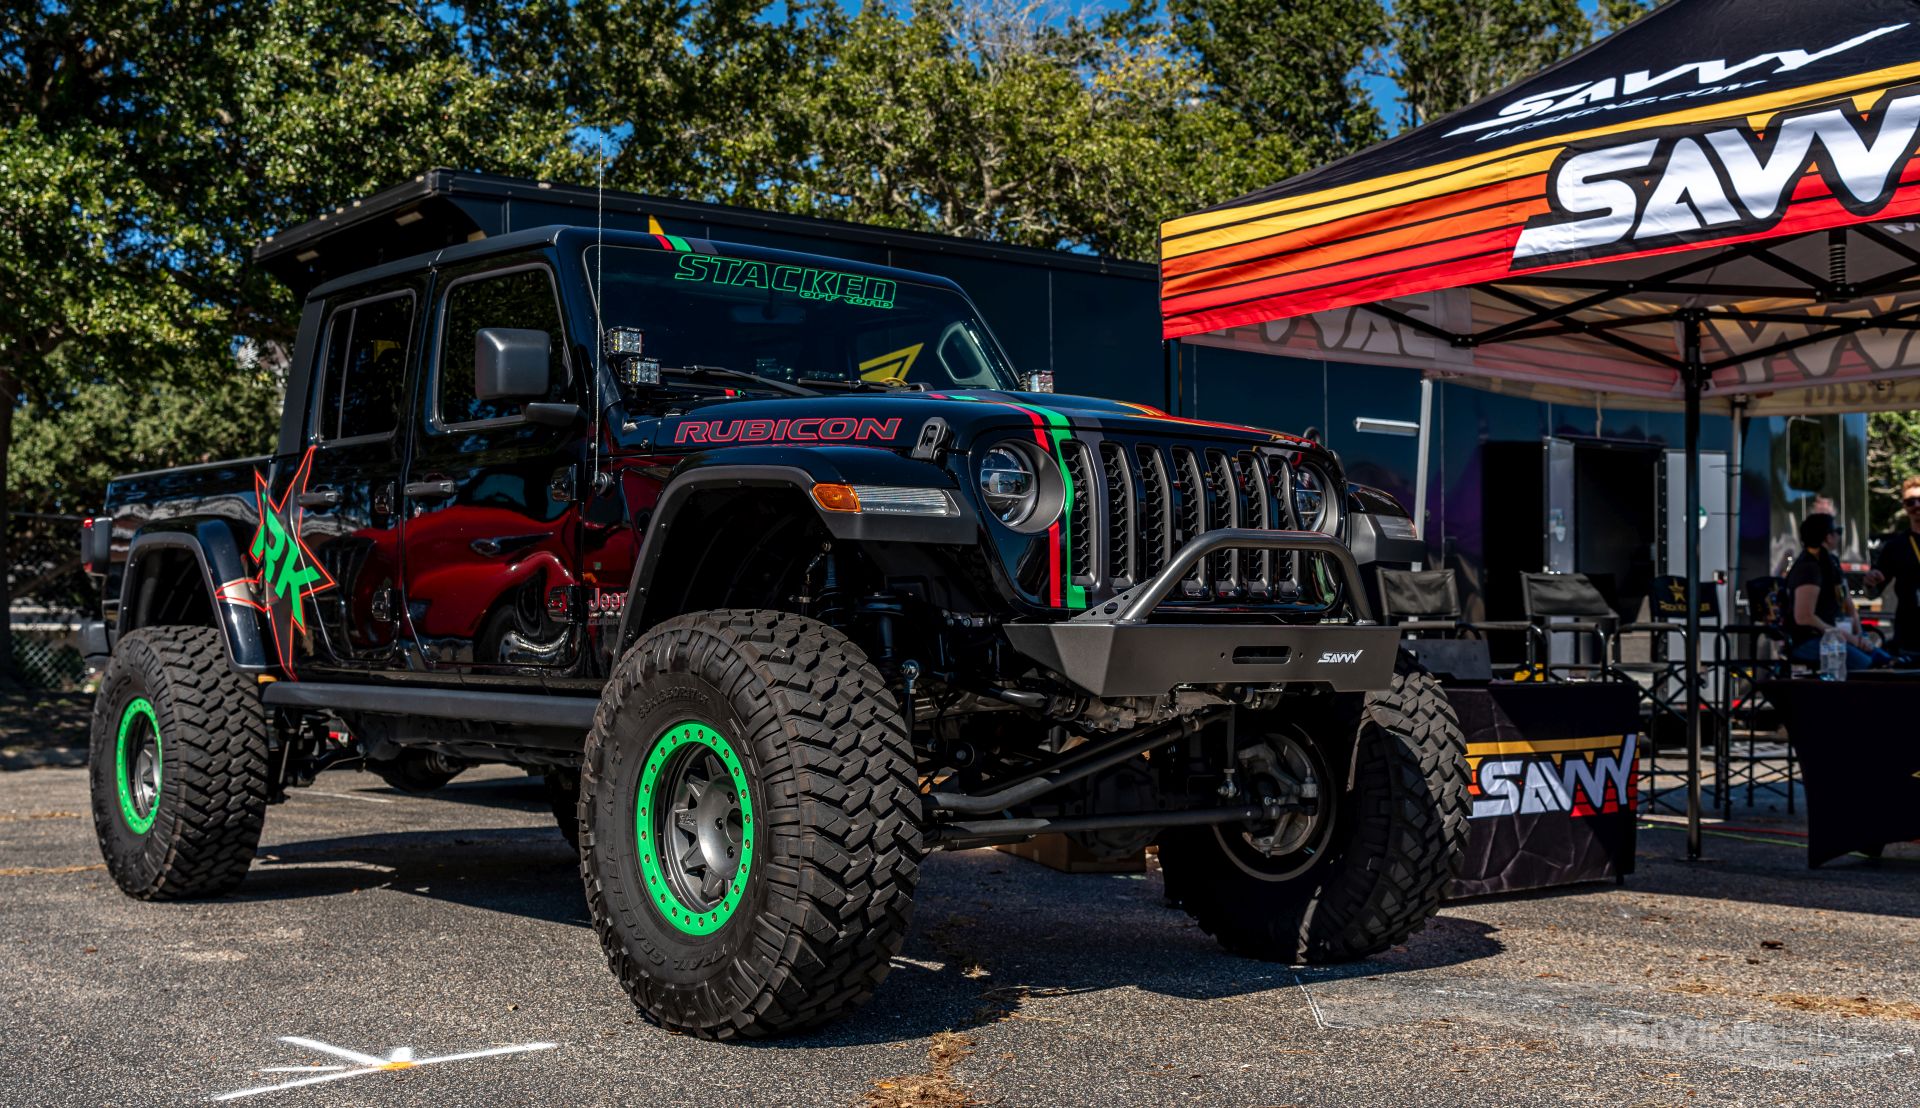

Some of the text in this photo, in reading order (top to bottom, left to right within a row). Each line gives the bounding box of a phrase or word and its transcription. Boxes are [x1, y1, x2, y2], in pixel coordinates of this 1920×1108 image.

[1442, 23, 1910, 138] SAVVY
[1512, 94, 1920, 260] SAVV
[674, 254, 897, 302] STACKED
[799, 290, 894, 309] OFF ROAD
[674, 417, 902, 444] RUBICON
[251, 492, 322, 627] RK
[1317, 650, 1363, 664] SAVVY
[1466, 733, 1637, 820] SAVVY
